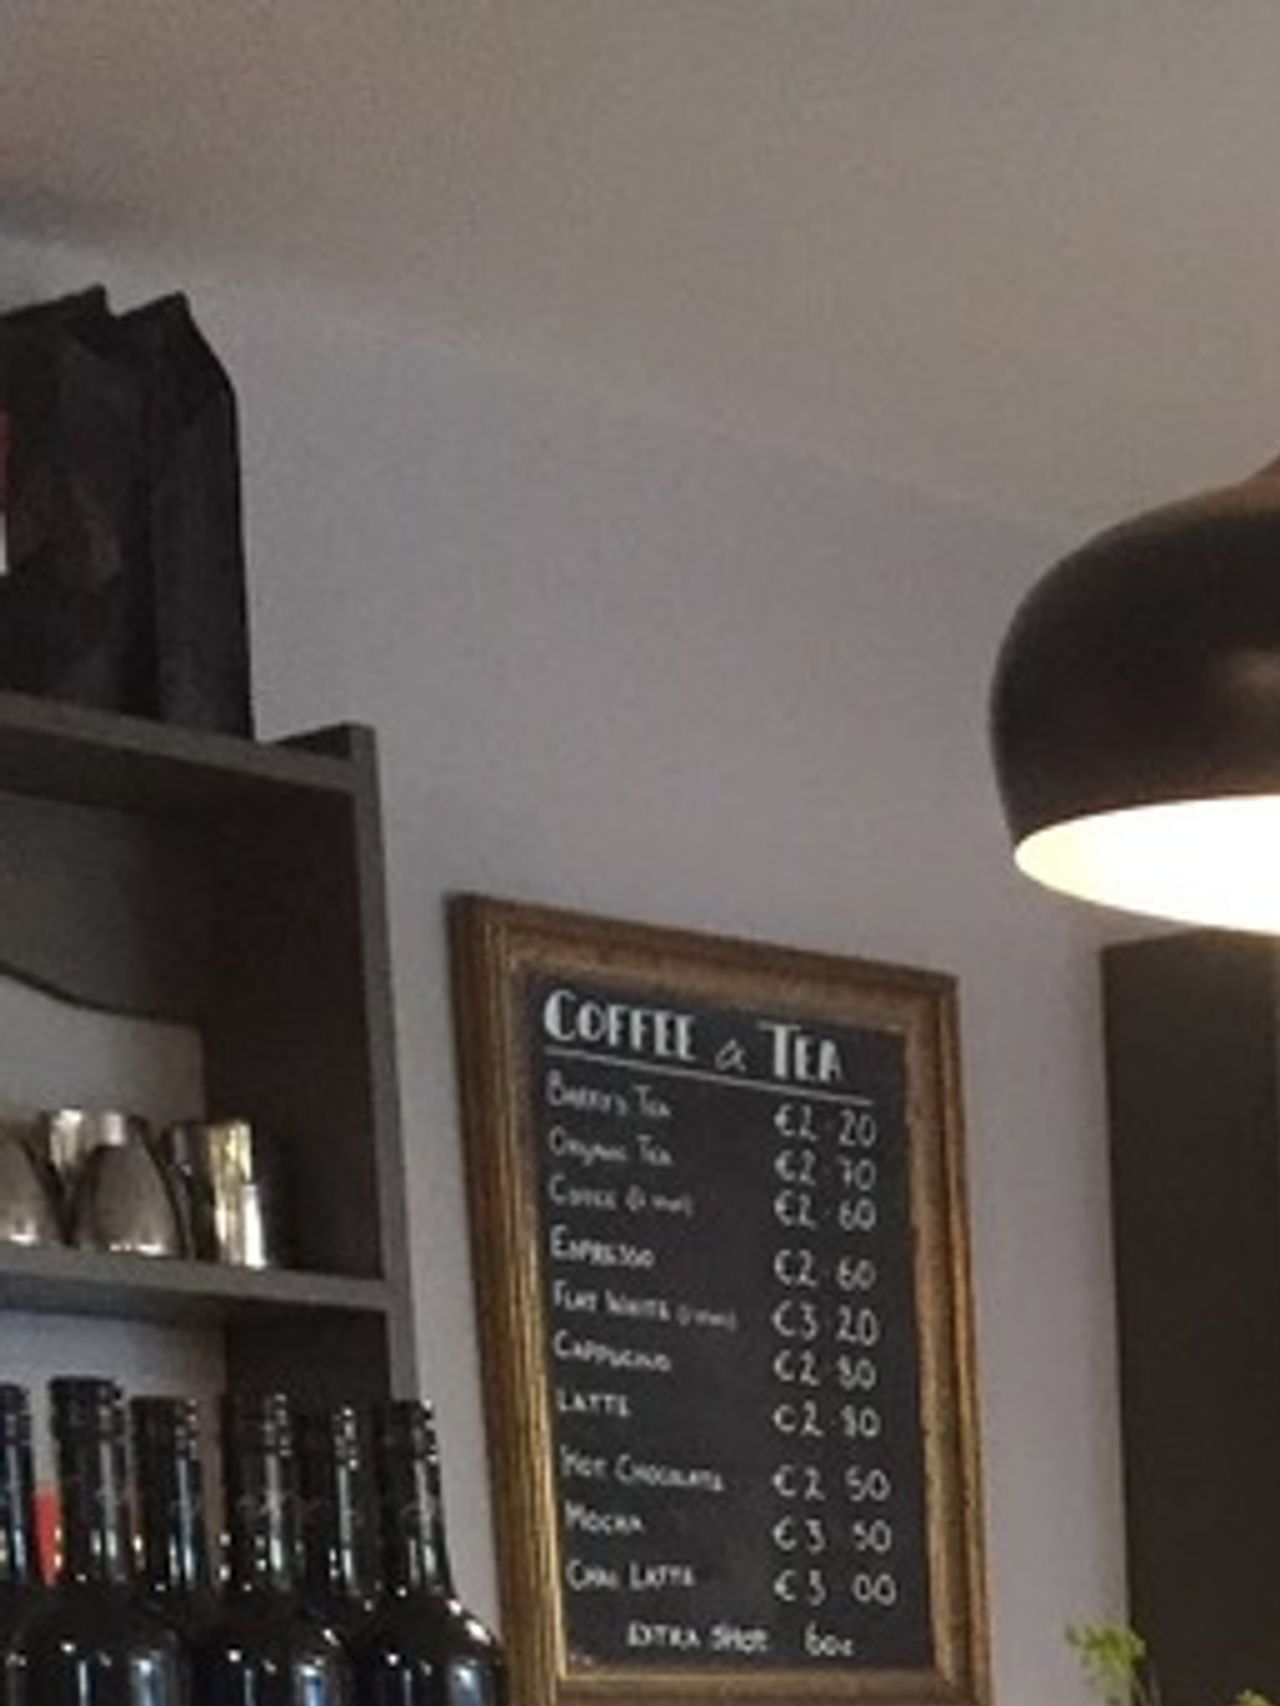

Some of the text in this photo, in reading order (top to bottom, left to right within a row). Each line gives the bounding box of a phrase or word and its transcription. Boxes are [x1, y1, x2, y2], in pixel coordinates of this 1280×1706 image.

[544, 989, 697, 1061] COFFEE
[757, 1019, 843, 1083] TEA
[556, 1388, 632, 1419] LATTE
